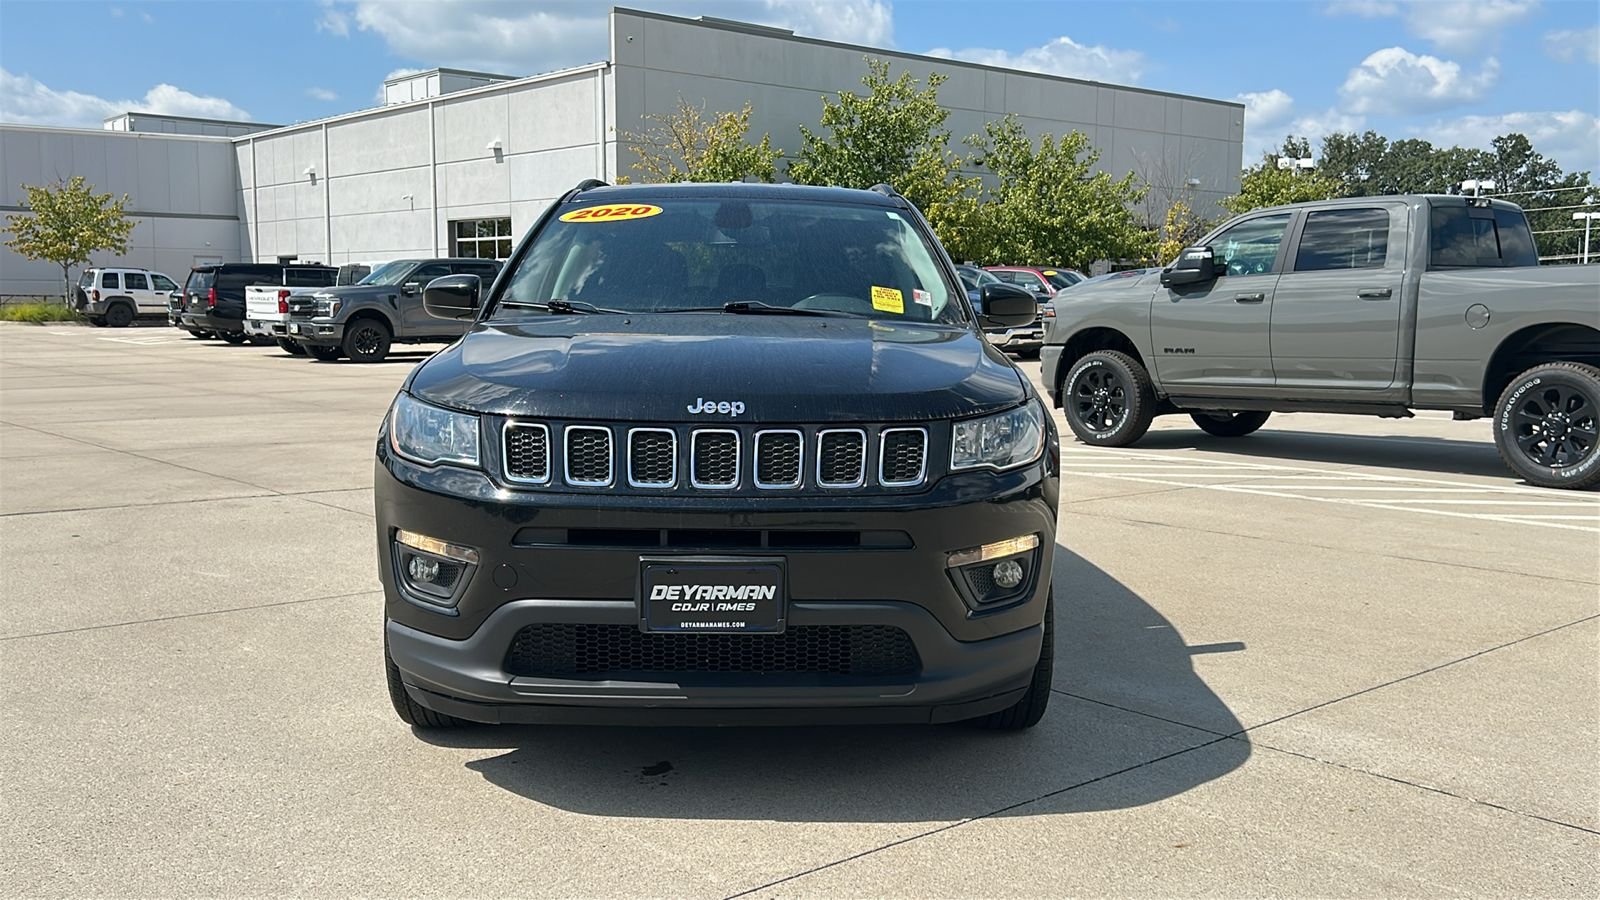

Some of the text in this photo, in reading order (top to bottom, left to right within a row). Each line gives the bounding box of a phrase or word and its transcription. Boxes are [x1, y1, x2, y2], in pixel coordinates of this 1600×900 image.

[568, 206, 652, 220] 2020
[687, 398, 746, 416] Jeep
[650, 584, 776, 600] DEYARMAN
